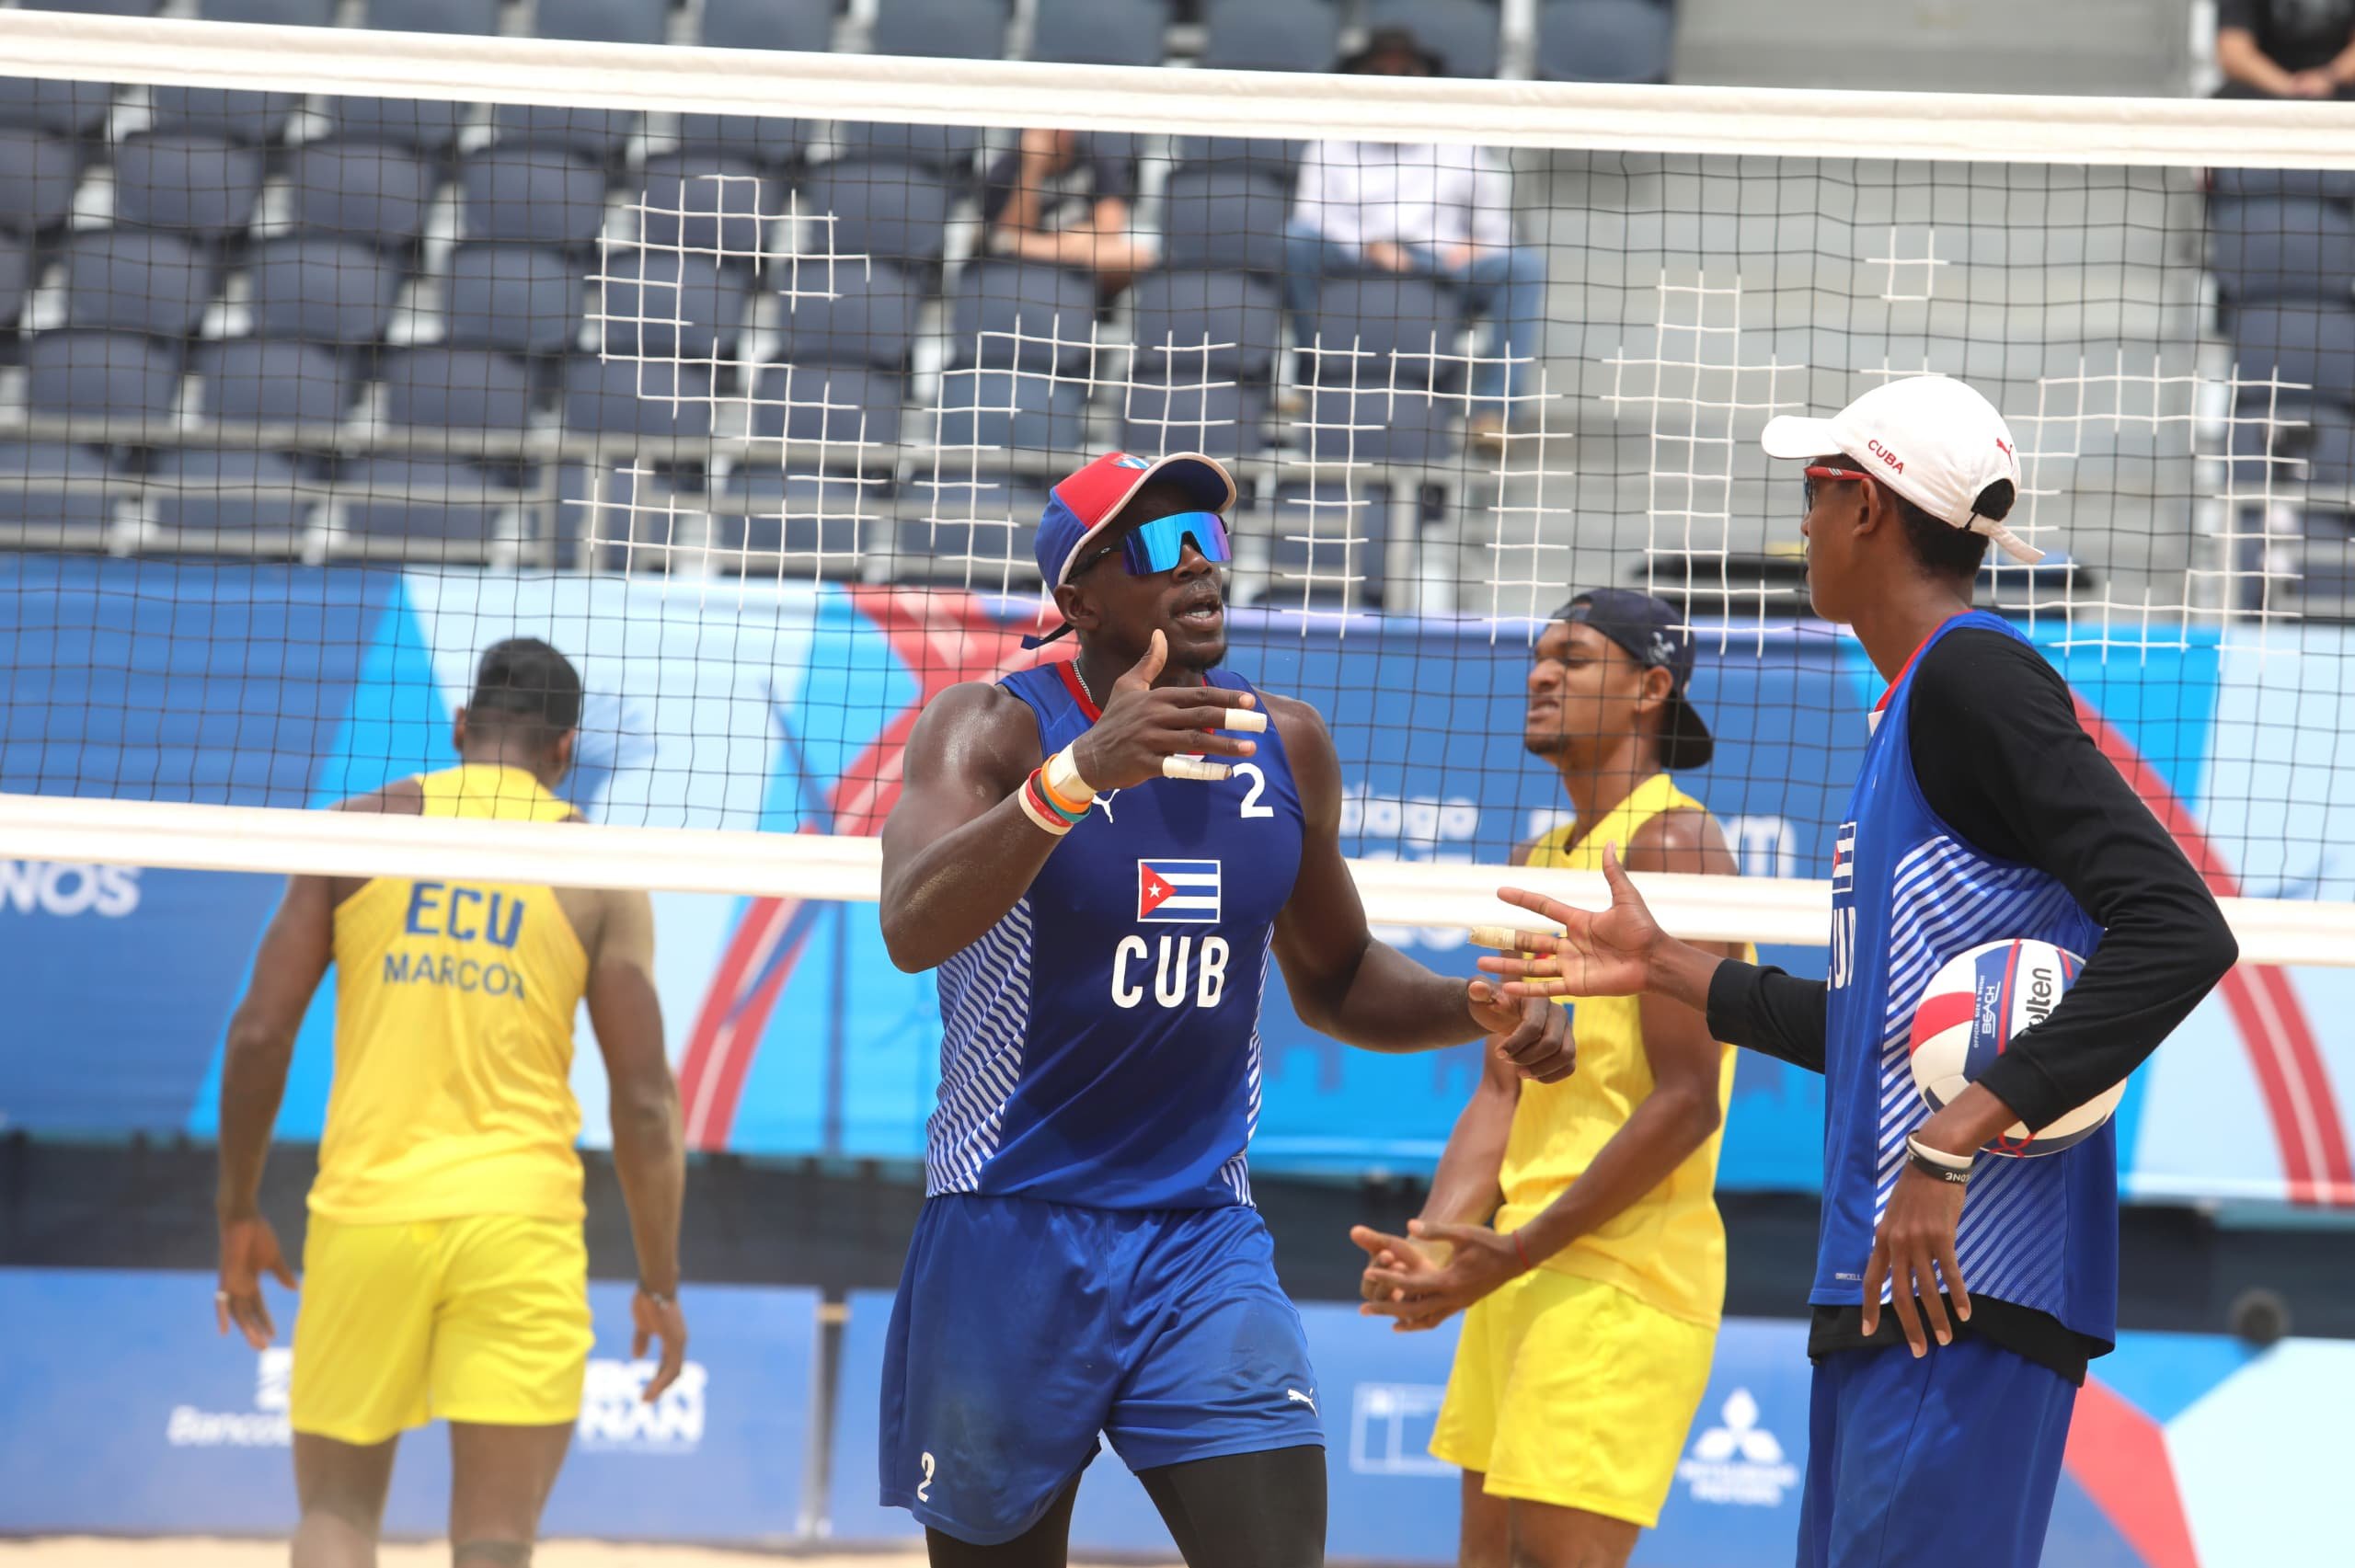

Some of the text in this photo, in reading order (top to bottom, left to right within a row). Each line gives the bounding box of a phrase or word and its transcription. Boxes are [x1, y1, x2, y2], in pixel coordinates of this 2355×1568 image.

[1867, 440, 1904, 475] CUBA
[1232, 762, 1274, 818] 2
[405, 881, 525, 950] ECU
[1111, 934, 1230, 1009] CUB
[2027, 968, 2052, 1027] olten
[1982, 986, 1996, 1036] BEACH
[917, 1451, 936, 1503] 2
